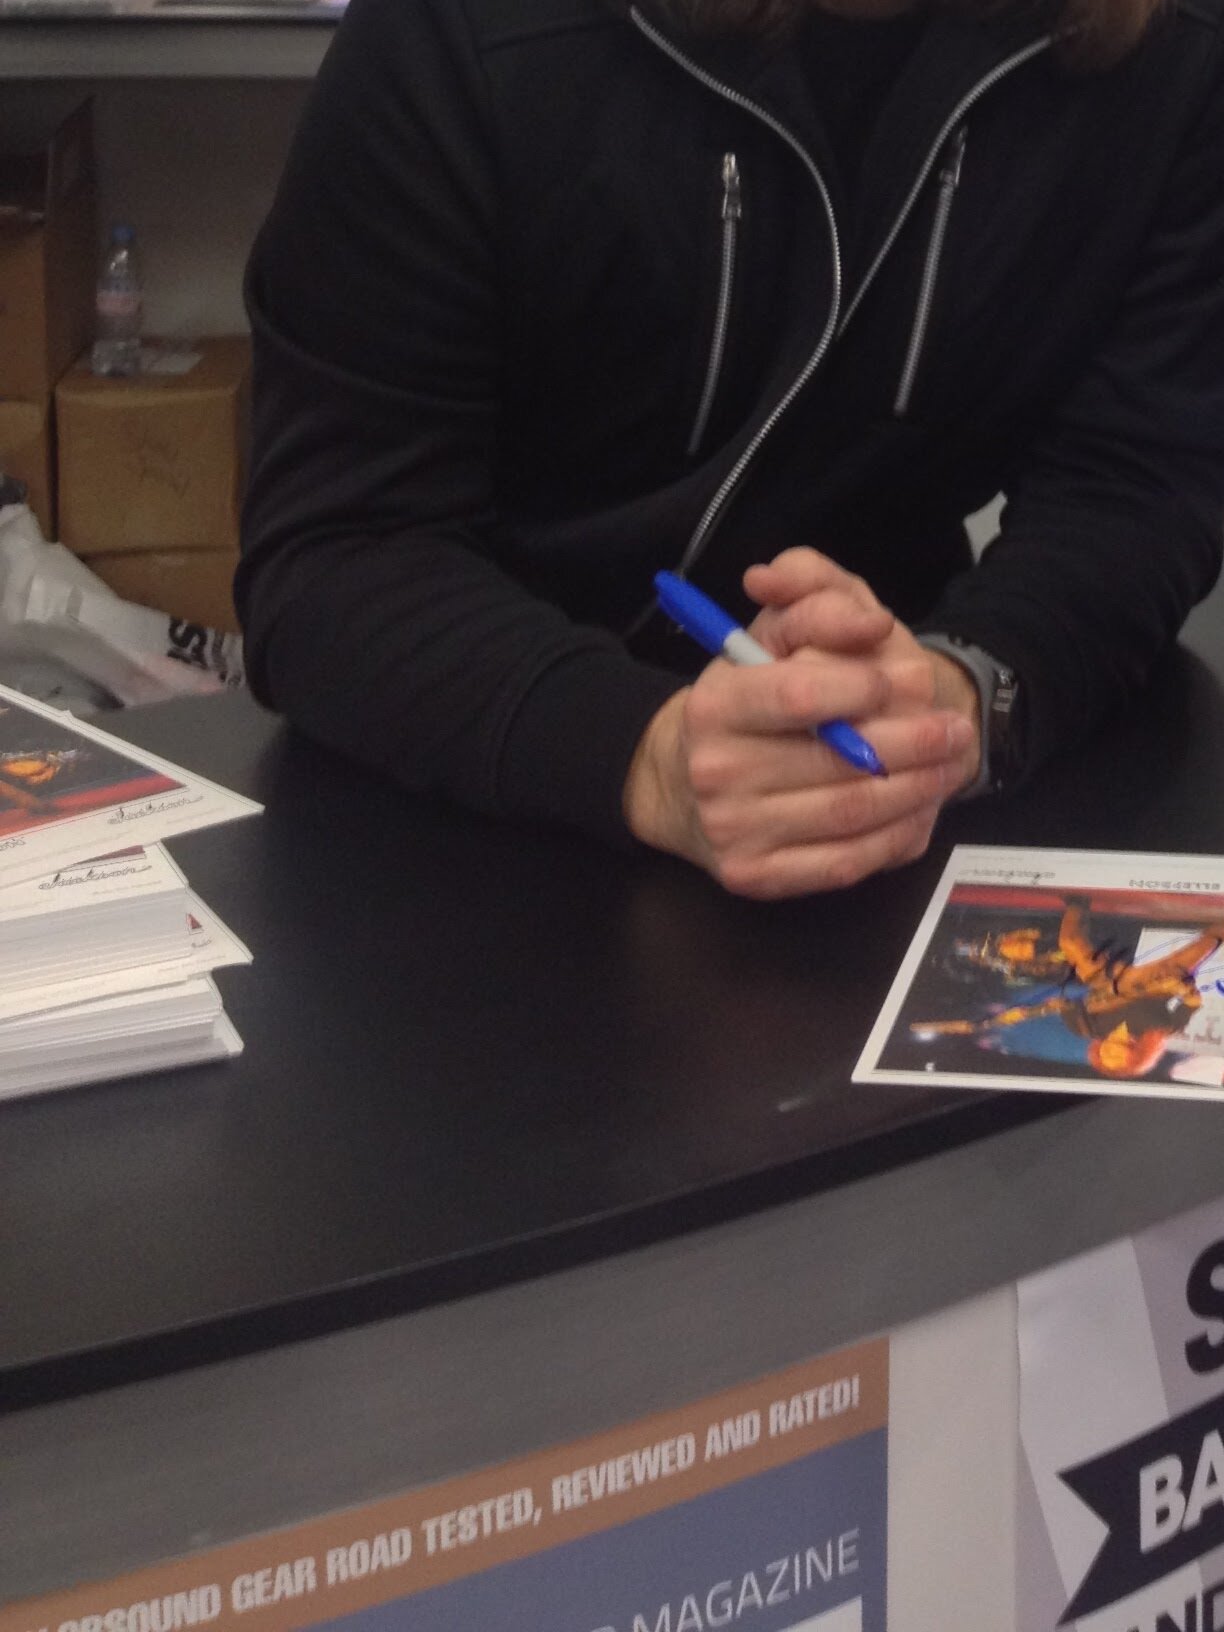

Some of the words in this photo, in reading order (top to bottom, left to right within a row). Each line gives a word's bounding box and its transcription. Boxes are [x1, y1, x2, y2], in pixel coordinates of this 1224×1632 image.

[231, 1555, 317, 1615] GEAR
[326, 1525, 412, 1586] ROAD
[420, 1486, 543, 1557] TESTED,
[551, 1431, 696, 1515] REVIEWED
[703, 1409, 761, 1463] AND
[768, 1373, 860, 1439] RATED!
